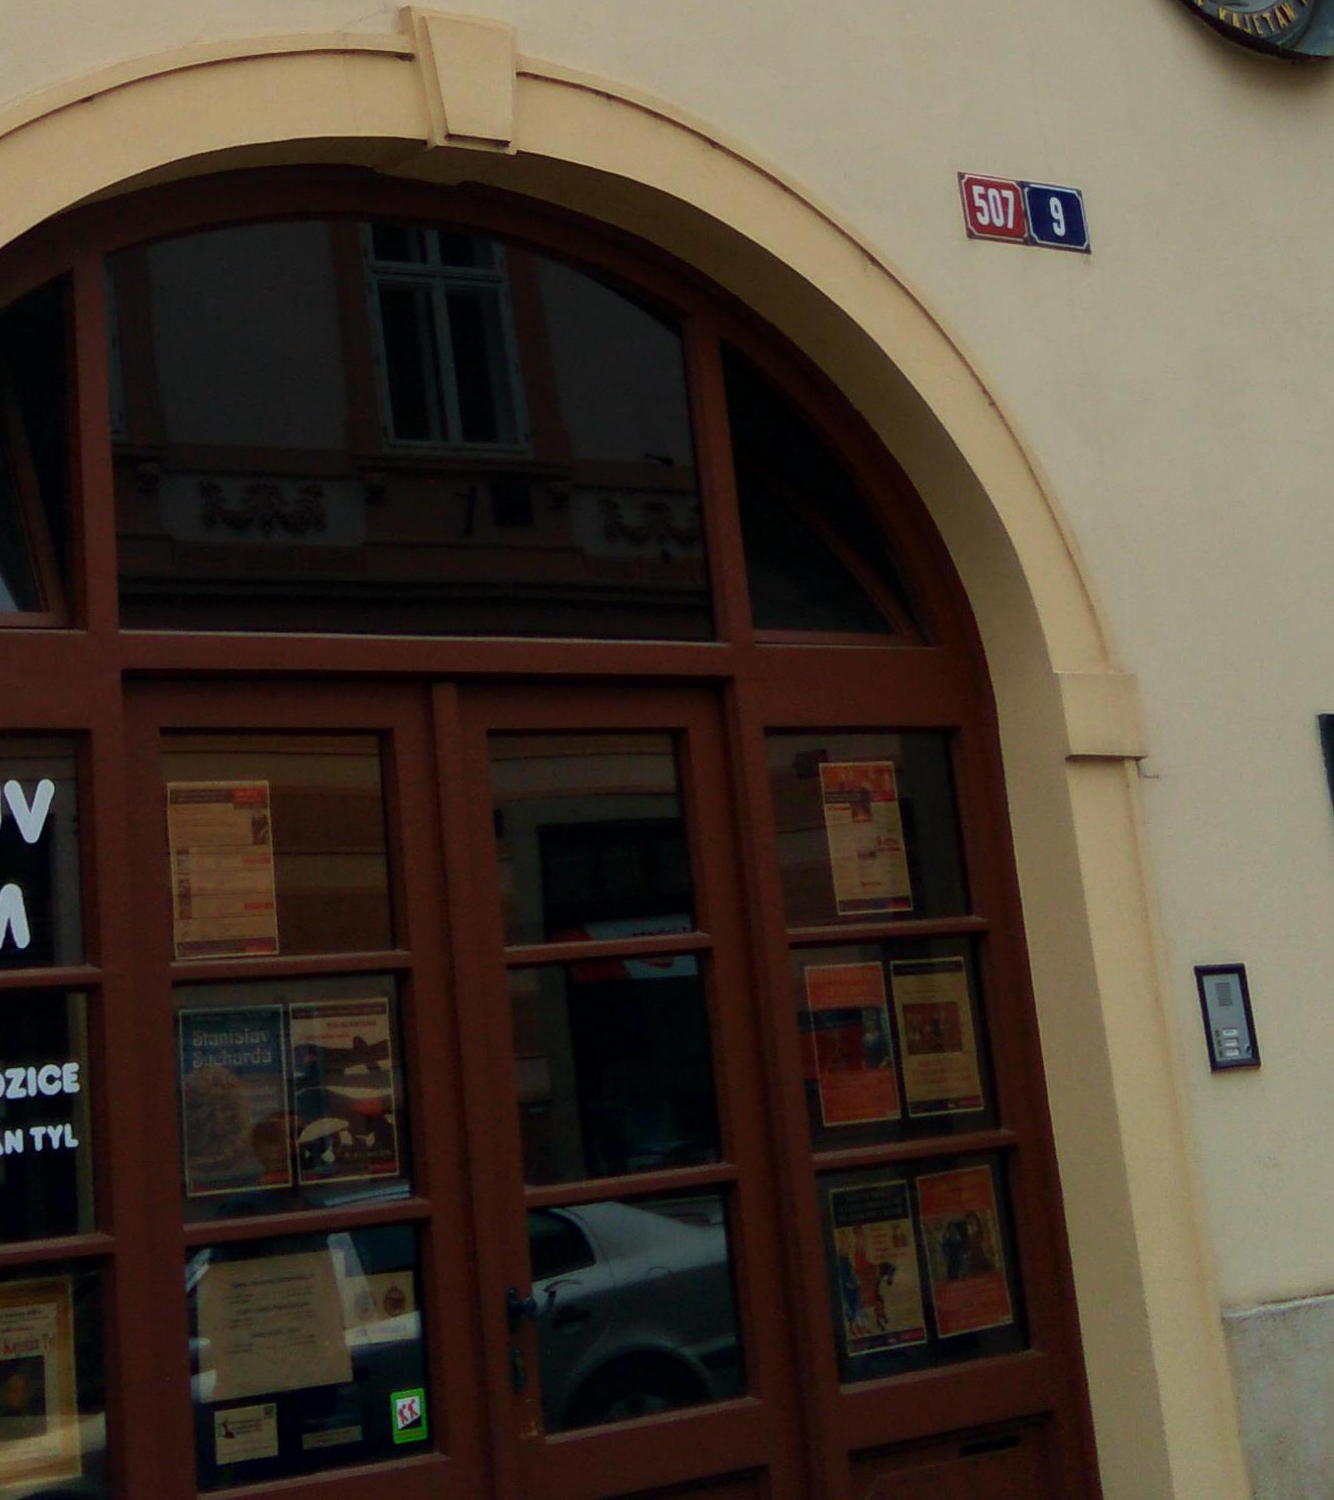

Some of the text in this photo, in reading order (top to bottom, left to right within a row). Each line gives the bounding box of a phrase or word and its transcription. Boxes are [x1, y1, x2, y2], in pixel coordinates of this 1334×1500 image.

[971, 184, 1015, 229] 507
[1049, 196, 1066, 237] 9
[192, 1047, 272, 1069] Sucharda
[29, 1123, 79, 1151] TYL
